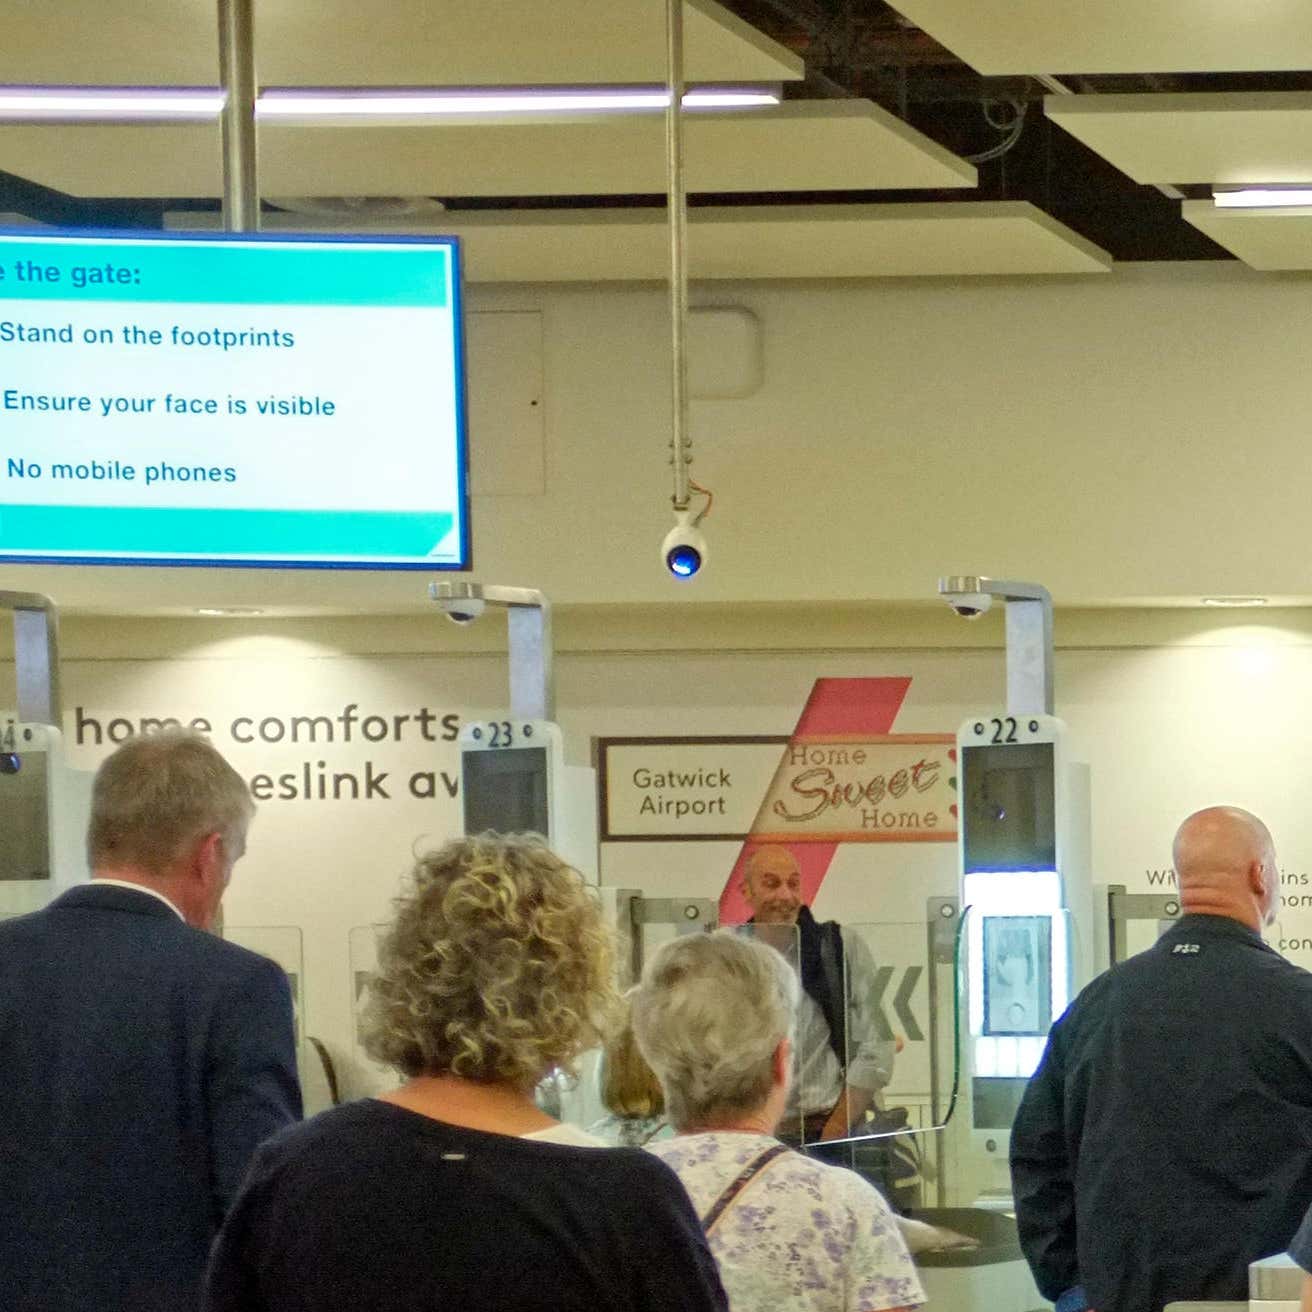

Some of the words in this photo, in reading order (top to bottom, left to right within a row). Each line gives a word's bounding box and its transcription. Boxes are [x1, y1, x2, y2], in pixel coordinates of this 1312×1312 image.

[15, 261, 60, 283] the
[71, 264, 141, 288] gate:
[0, 322, 72, 343] Stand
[84, 328, 113, 344] on
[123, 325, 162, 345] the
[172, 326, 294, 351] footprints
[4, 390, 91, 411] Ensure
[100, 397, 155, 416] your
[165, 394, 218, 414] face
[228, 395, 247, 414] is
[256, 396, 335, 416] visible
[8, 458, 41, 479] No
[52, 461, 135, 481] mobile
[146, 462, 236, 485] phones
[231, 704, 459, 743] comforts
[488, 721, 512, 747] 23
[991, 718, 1017, 743] 22
[789, 746, 867, 766] Home
[633, 768, 731, 789] Gatwick
[773, 758, 941, 823] Sweet
[640, 795, 725, 819] Airport
[861, 808, 938, 828] Home
